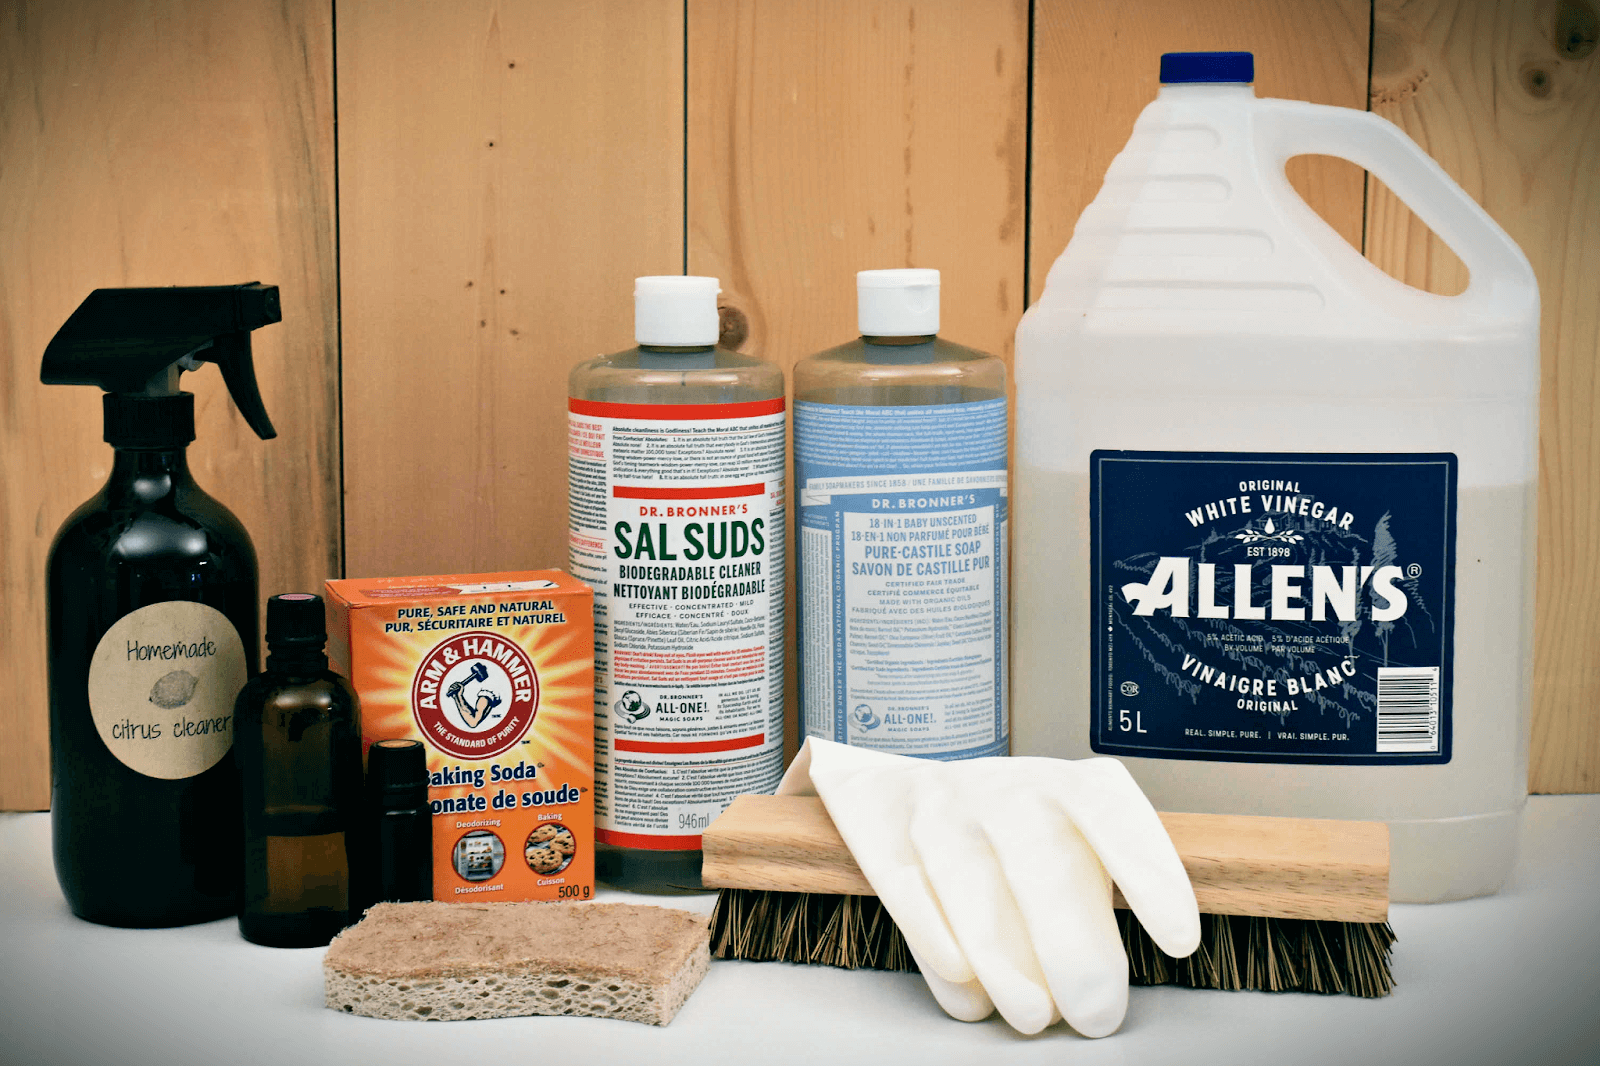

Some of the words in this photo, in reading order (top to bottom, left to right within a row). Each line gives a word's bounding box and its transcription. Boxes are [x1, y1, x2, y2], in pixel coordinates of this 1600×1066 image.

[826, 480, 864, 490] SOAPMAKERS
[866, 480, 886, 488] SINCE
[889, 479, 906, 487] 1858
[912, 478, 926, 486] UNE
[928, 476, 955, 485] FAMILLE
[1239, 480, 1300, 493] ORIGINAL
[872, 498, 896, 509] DR.
[898, 494, 976, 508] BRONNER'S
[640, 506, 663, 517] DR.
[666, 504, 748, 517] BRONNER'S
[1185, 496, 1252, 528] WHITE
[1260, 494, 1354, 530] VINEGAR
[904, 518, 928, 528] BABY
[930, 514, 976, 528] UNSCENTED
[886, 532, 906, 542] NON
[909, 528, 950, 541] PARFUMÉ
[952, 528, 972, 539] POUR
[974, 522, 990, 536] BÉBÉ
[614, 520, 677, 561] SAL
[683, 518, 764, 561] SUDS
[865, 544, 952, 559] PURE-CASTILE
[955, 540, 980, 556] SOAP
[1248, 547, 1264, 557] EST
[1268, 547, 1290, 558] 1898
[620, 564, 714, 581] BIODEGRADABLE
[720, 562, 761, 579] CLEANER
[852, 562, 892, 576] SAVON
[897, 562, 912, 576] DE
[916, 558, 970, 576] CASTILLE
[972, 556, 990, 570] PUR
[944, 577, 965, 586] TRADE
[614, 583, 678, 600] NETTOYANT
[682, 579, 765, 600] BIODÉGRADABLE
[1120, 556, 1408, 622] ALLEN'S
[674, 602, 734, 610] CONCENTRATED
[924, 596, 956, 604] ORGANIC
[398, 608, 434, 619] PURE,
[437, 605, 466, 617] SAFE
[470, 604, 496, 615] AND
[499, 600, 554, 613] NATURAL
[680, 610, 724, 619] CONCENTRÉ
[852, 606, 886, 614] FABRIQUÉ
[385, 622, 414, 633] PUR,
[417, 617, 493, 632] SÉCURITAIRE
[496, 616, 510, 626] ET
[512, 612, 566, 626] NATUREL
[1220, 634, 1244, 642] ACETIC
[1272, 634, 1284, 642] 5%
[1286, 635, 1314, 644] D'ACIDE
[1316, 634, 1350, 644] ACÉTIQUE
[127, 636, 217, 661] Homemade
[1236, 644, 1264, 652] VOLUME
[1288, 646, 1316, 654] VOLUME
[420, 659, 447, 710] ARM
[442, 647, 462, 664] &
[462, 638, 532, 702] HAMMER
[1182, 654, 1278, 696] VINAIGRE
[1286, 660, 1356, 696] BLANC
[656, 702, 707, 714] ALL-ONE!
[1236, 698, 1298, 712] ORIGINAL
[884, 713, 932, 724] ALL-ONE!
[1120, 710, 1132, 732] 5
[1136, 710, 1148, 734] L
[112, 719, 162, 740] citrus
[173, 715, 232, 738] cleaner
[434, 721, 447, 737] THE
[445, 733, 486, 748] STANDARD
[486, 735, 498, 745] OF
[498, 716, 520, 740] PURITY
[1184, 728, 1206, 737] REAL.
[1208, 729, 1238, 738] SIMPLE.
[1240, 730, 1262, 739] PURE.
[1277, 732, 1298, 740] VRAI.
[1300, 732, 1330, 740] SIMPLE.
[1332, 733, 1350, 741] PUR.
[490, 761, 536, 782] Soda
[492, 790, 516, 809] de
[522, 784, 580, 806] soude
[456, 819, 501, 828] Deodorizing
[538, 812, 562, 822] Baking
[455, 884, 504, 894] Désodorisant
[536, 878, 565, 886] Cuisson
[558, 885, 580, 898] 500
[583, 886, 590, 898] g
